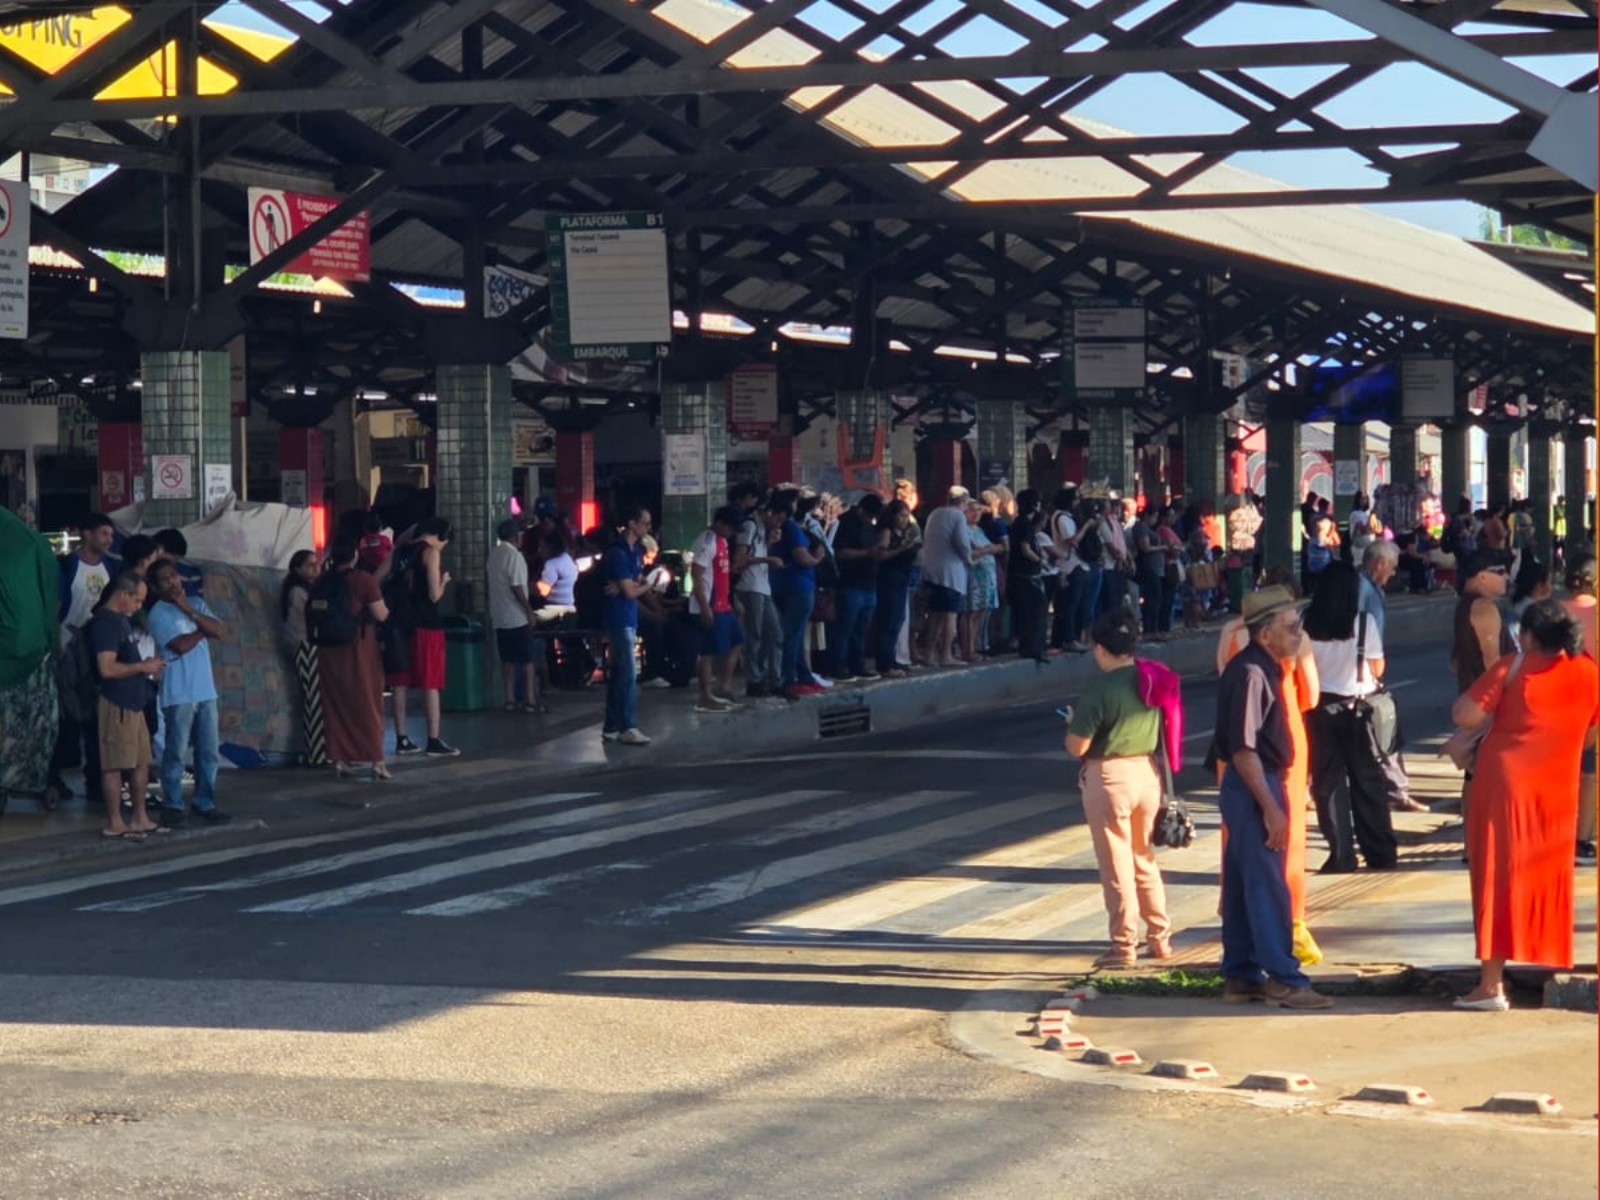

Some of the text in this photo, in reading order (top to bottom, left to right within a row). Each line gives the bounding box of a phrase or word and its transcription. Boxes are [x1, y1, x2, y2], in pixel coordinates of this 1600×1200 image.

[560, 213, 664, 228] PLATAFORMA B1
[573, 346, 629, 360] EMBARQUE
